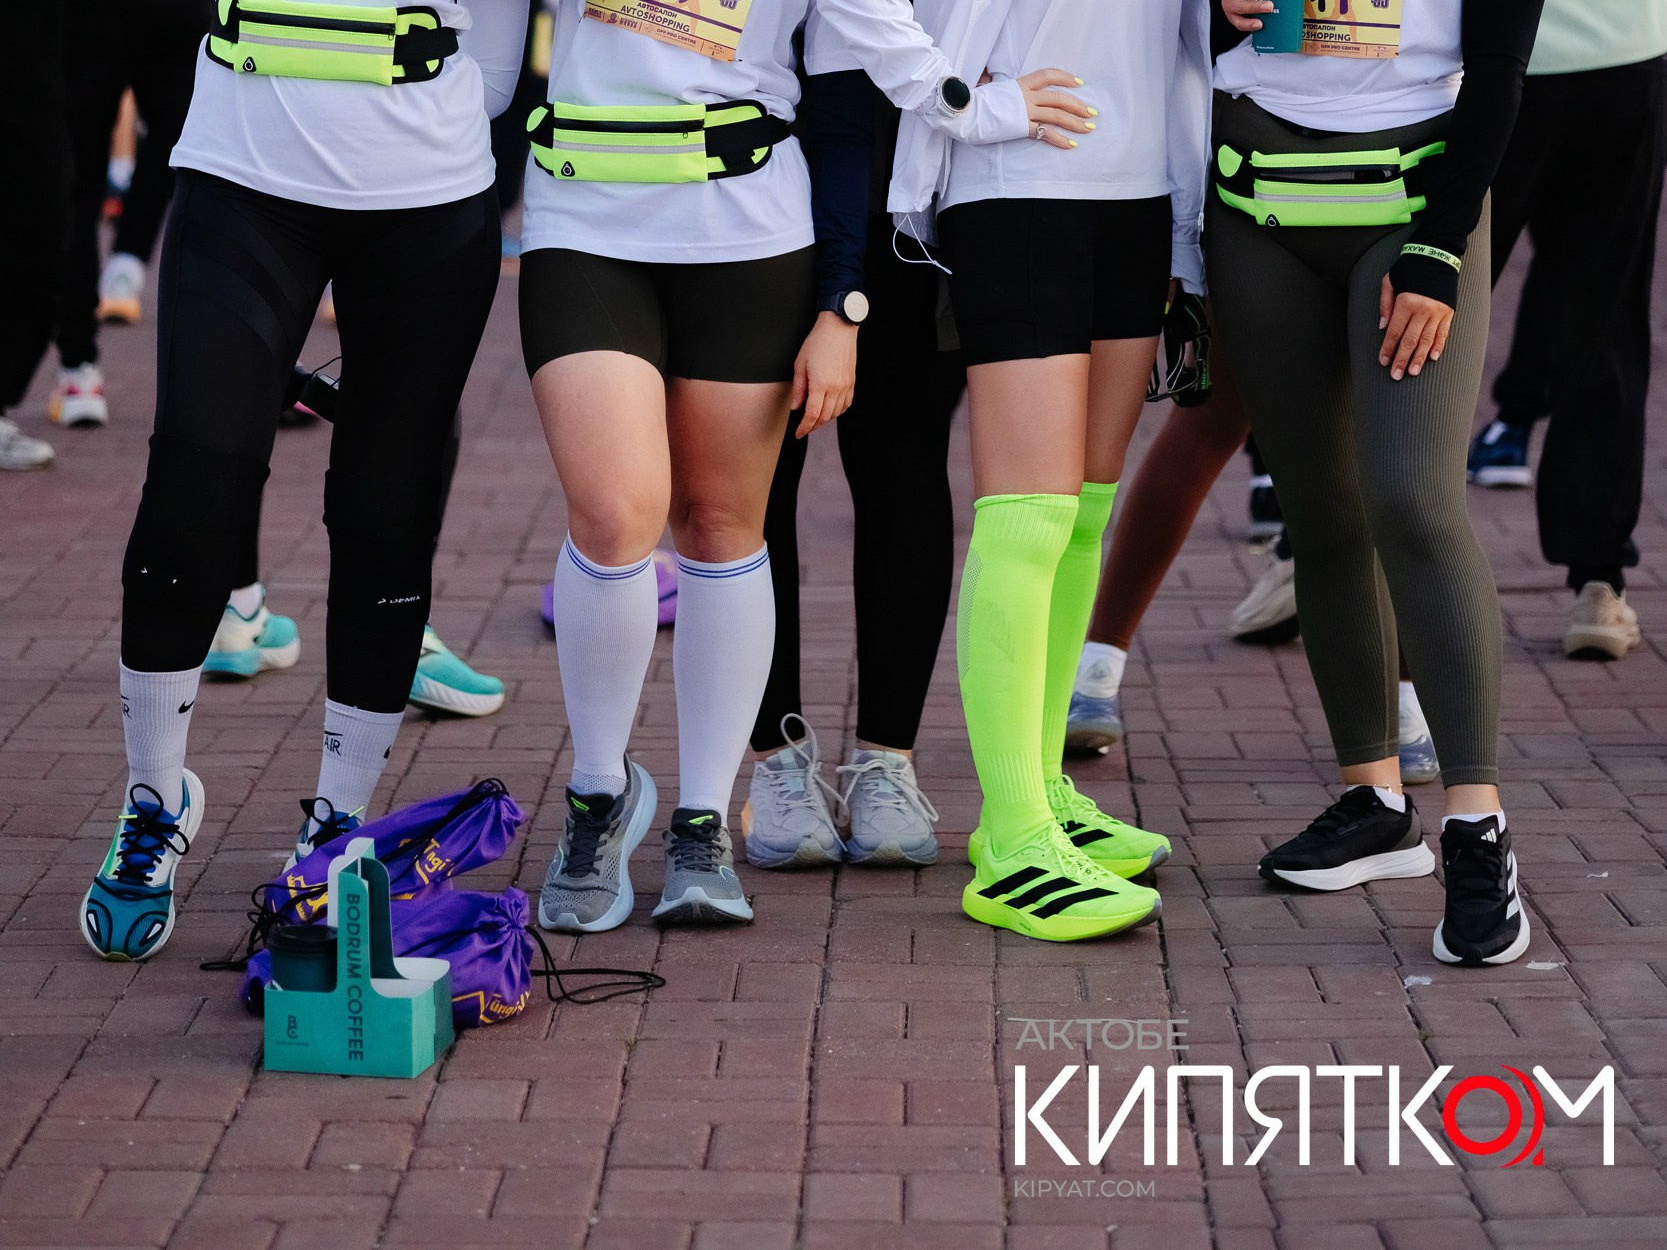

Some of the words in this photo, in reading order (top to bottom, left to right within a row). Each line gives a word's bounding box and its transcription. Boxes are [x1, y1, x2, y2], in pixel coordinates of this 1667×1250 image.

[620, 5, 690, 33] AVTOSHOPPING
[636, 2, 678, 18] АВТОСАЛОН
[1302, 32, 1351, 41] OSHOPPING
[324, 736, 341, 756] AIR
[346, 893, 361, 979] BODRUM
[347, 985, 363, 1061] COFFEE
